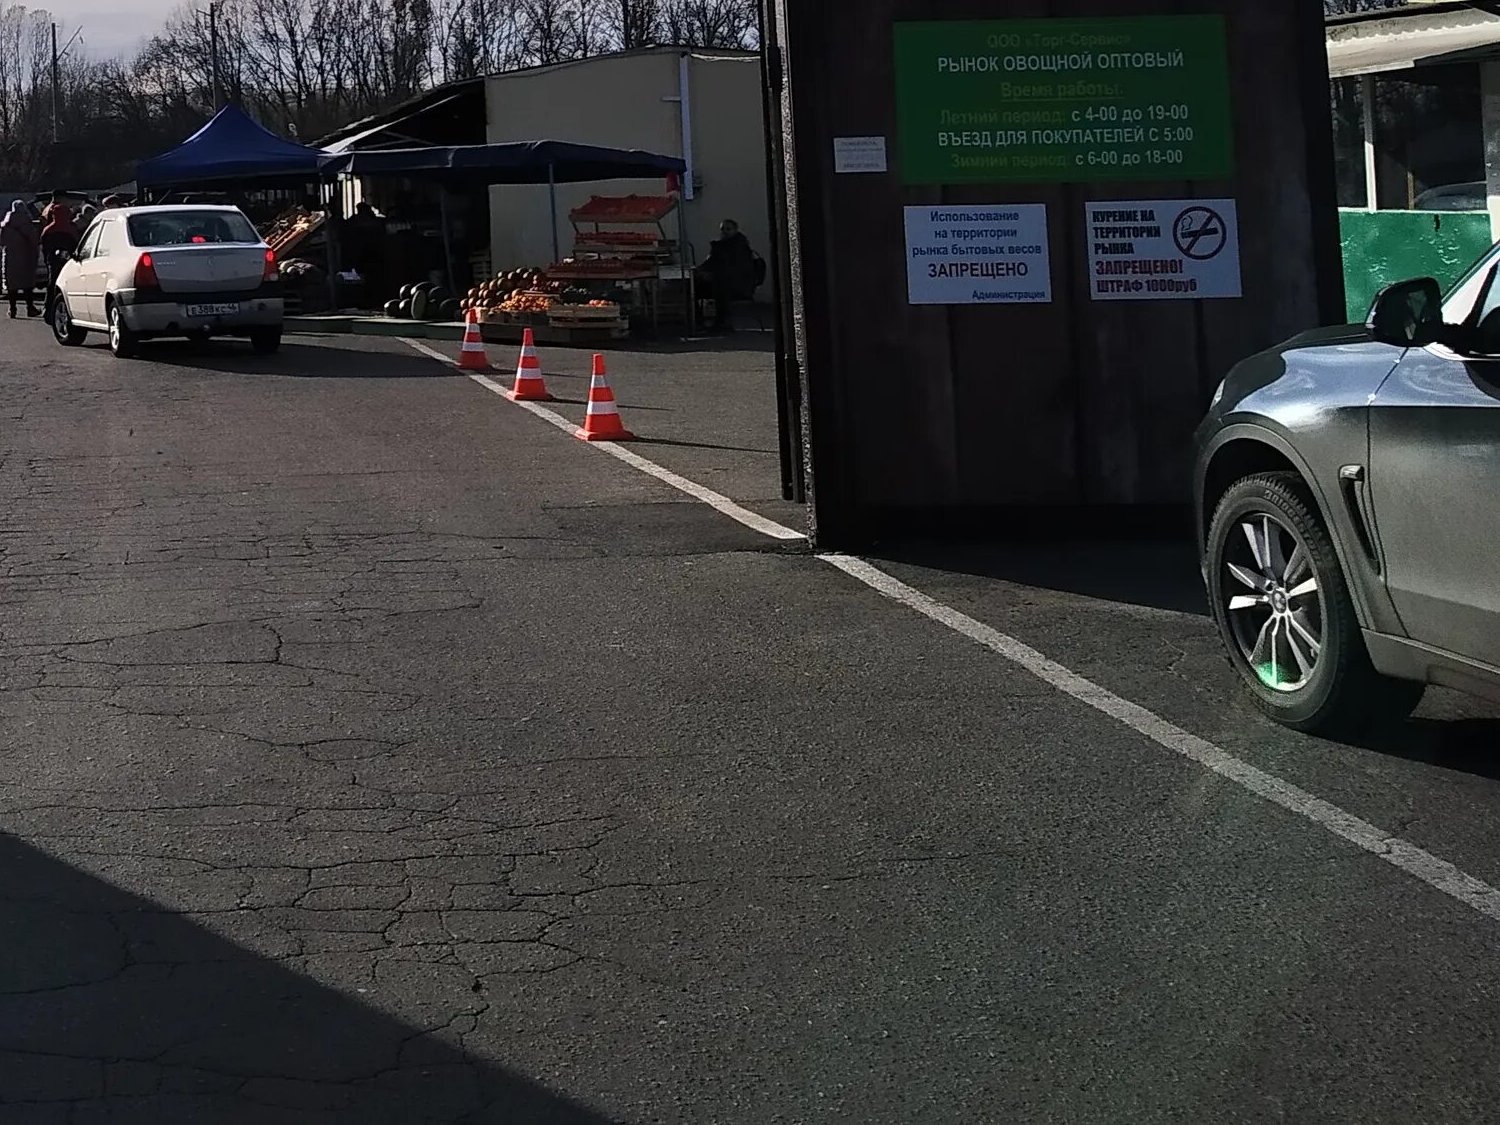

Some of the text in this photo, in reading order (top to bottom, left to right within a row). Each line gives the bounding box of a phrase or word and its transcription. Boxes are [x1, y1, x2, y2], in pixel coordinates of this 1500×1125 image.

[938, 48, 1185, 73] РЫНОК ОВОЩНОЙ ОПТОВЫЙ
[1000, 82, 1054, 99] Время
[940, 107, 998, 125] Летний
[1072, 111, 1080, 122] с
[1085, 106, 1117, 122] 4-00
[1122, 109, 1142, 123] до
[1148, 104, 1189, 121] 19-00
[938, 131, 992, 148] ВЪЕЗД
[995, 129, 1027, 145] ДЛЯ
[1031, 125, 1145, 145] ПОКУПАТЕЛЕЙ
[1164, 126, 1194, 142] 5:00
[1087, 151, 1117, 166] 6-00
[1122, 153, 1141, 166] до
[1145, 148, 1183, 164] 18-00
[930, 210, 1020, 222] Использование
[1092, 209, 1155, 223] КУРЕНИЕ НА
[934, 227, 1018, 241] на территории
[1093, 225, 1161, 239] ТЕРРИТОРИИ
[912, 243, 1042, 257] рынка бытовых весов
[1094, 242, 1134, 255] РЫНКА
[928, 262, 1028, 279] ЗАПРЕЩЕНО
[1096, 259, 1183, 276] ЗАПРЕЩЕНО!
[1097, 280, 1143, 293] ШТРАФ
[972, 289, 1046, 301] Администрация
